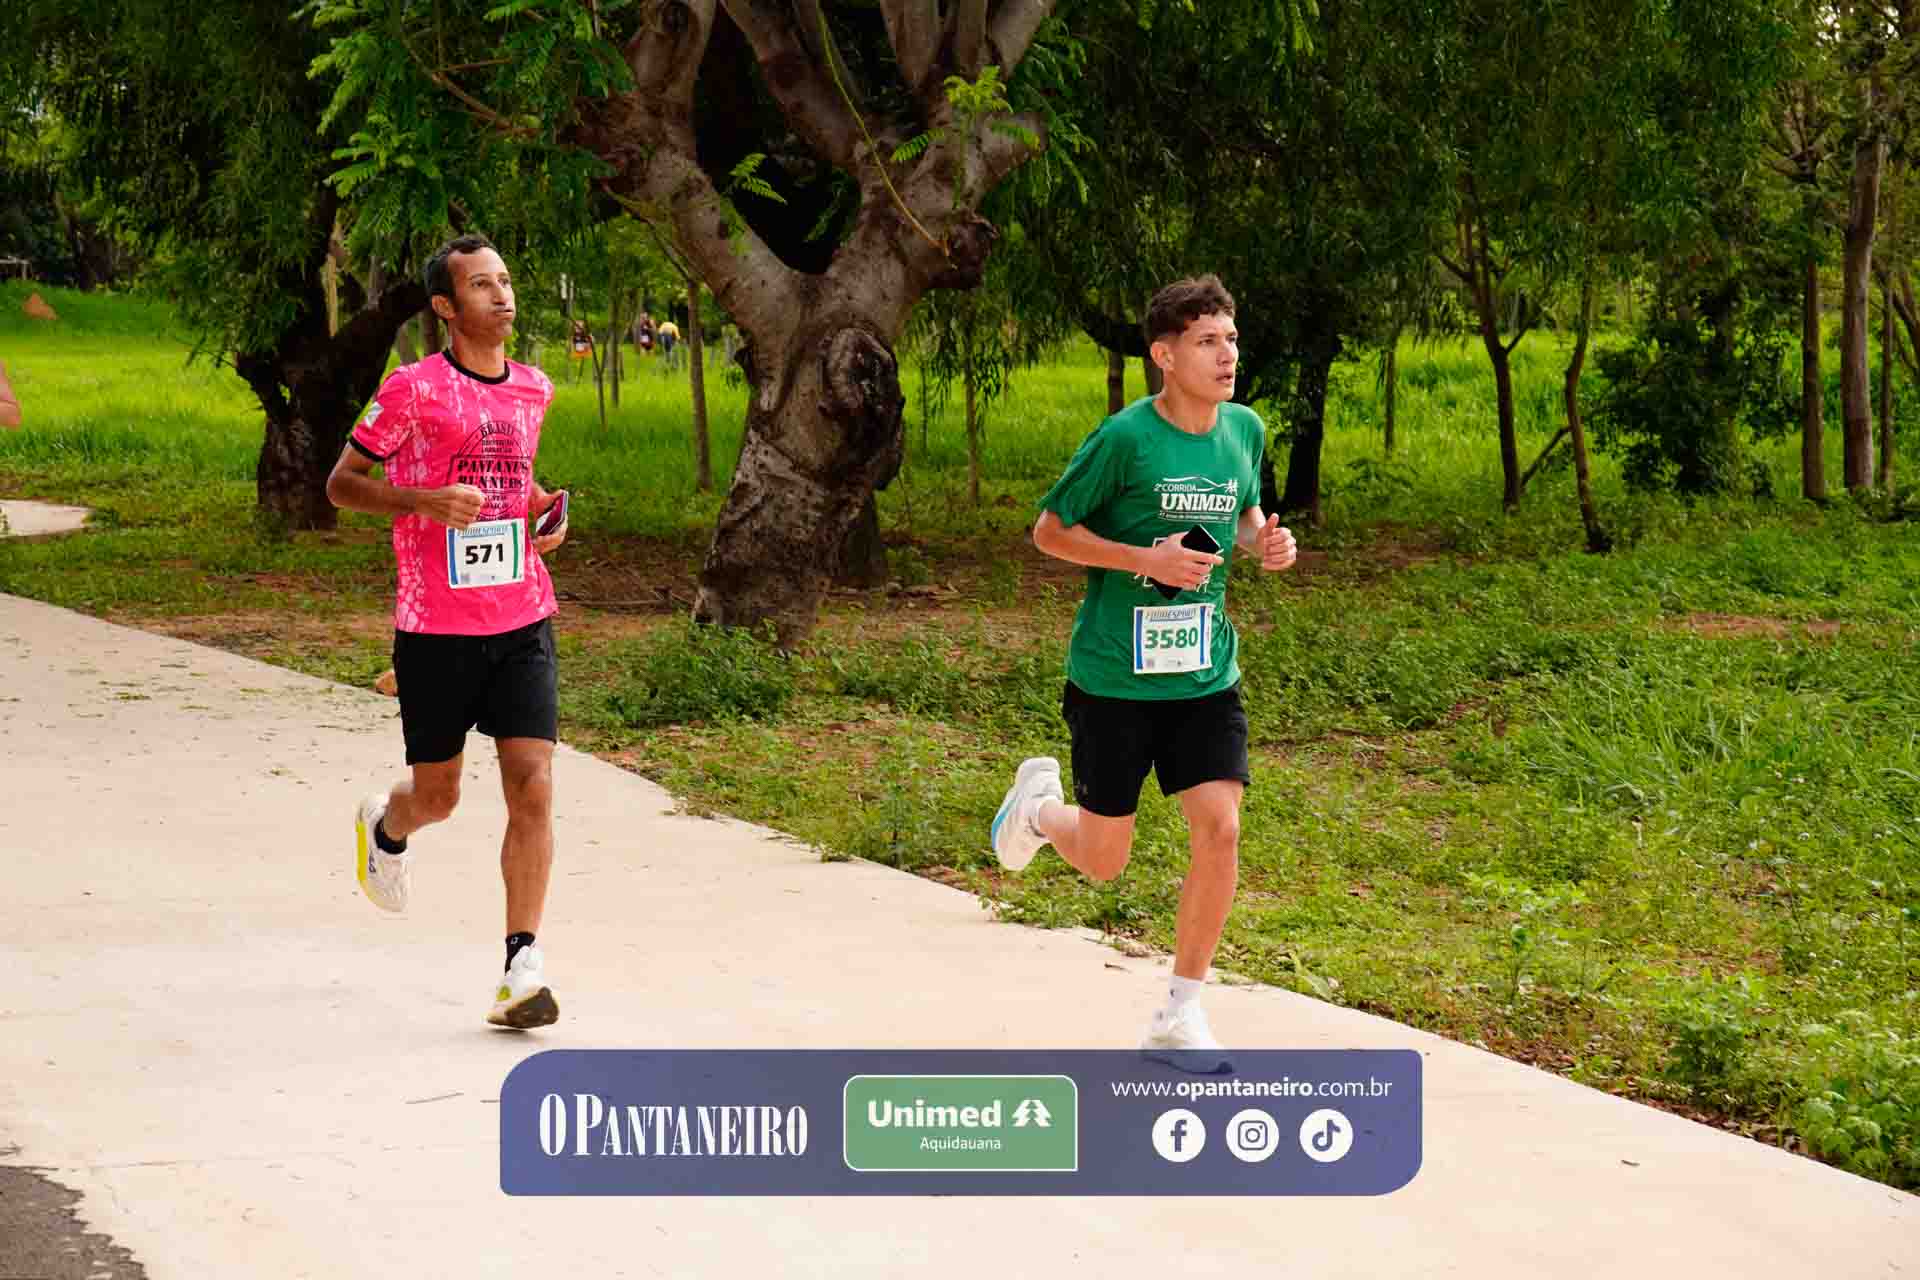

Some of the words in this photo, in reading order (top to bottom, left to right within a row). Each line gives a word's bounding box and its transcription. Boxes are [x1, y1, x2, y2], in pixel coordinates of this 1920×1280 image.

[1161, 483, 1197, 492] CORRIDA
[1161, 493, 1237, 513] UNIMED
[465, 543, 504, 565] 571
[1144, 627, 1198, 649] 3580
